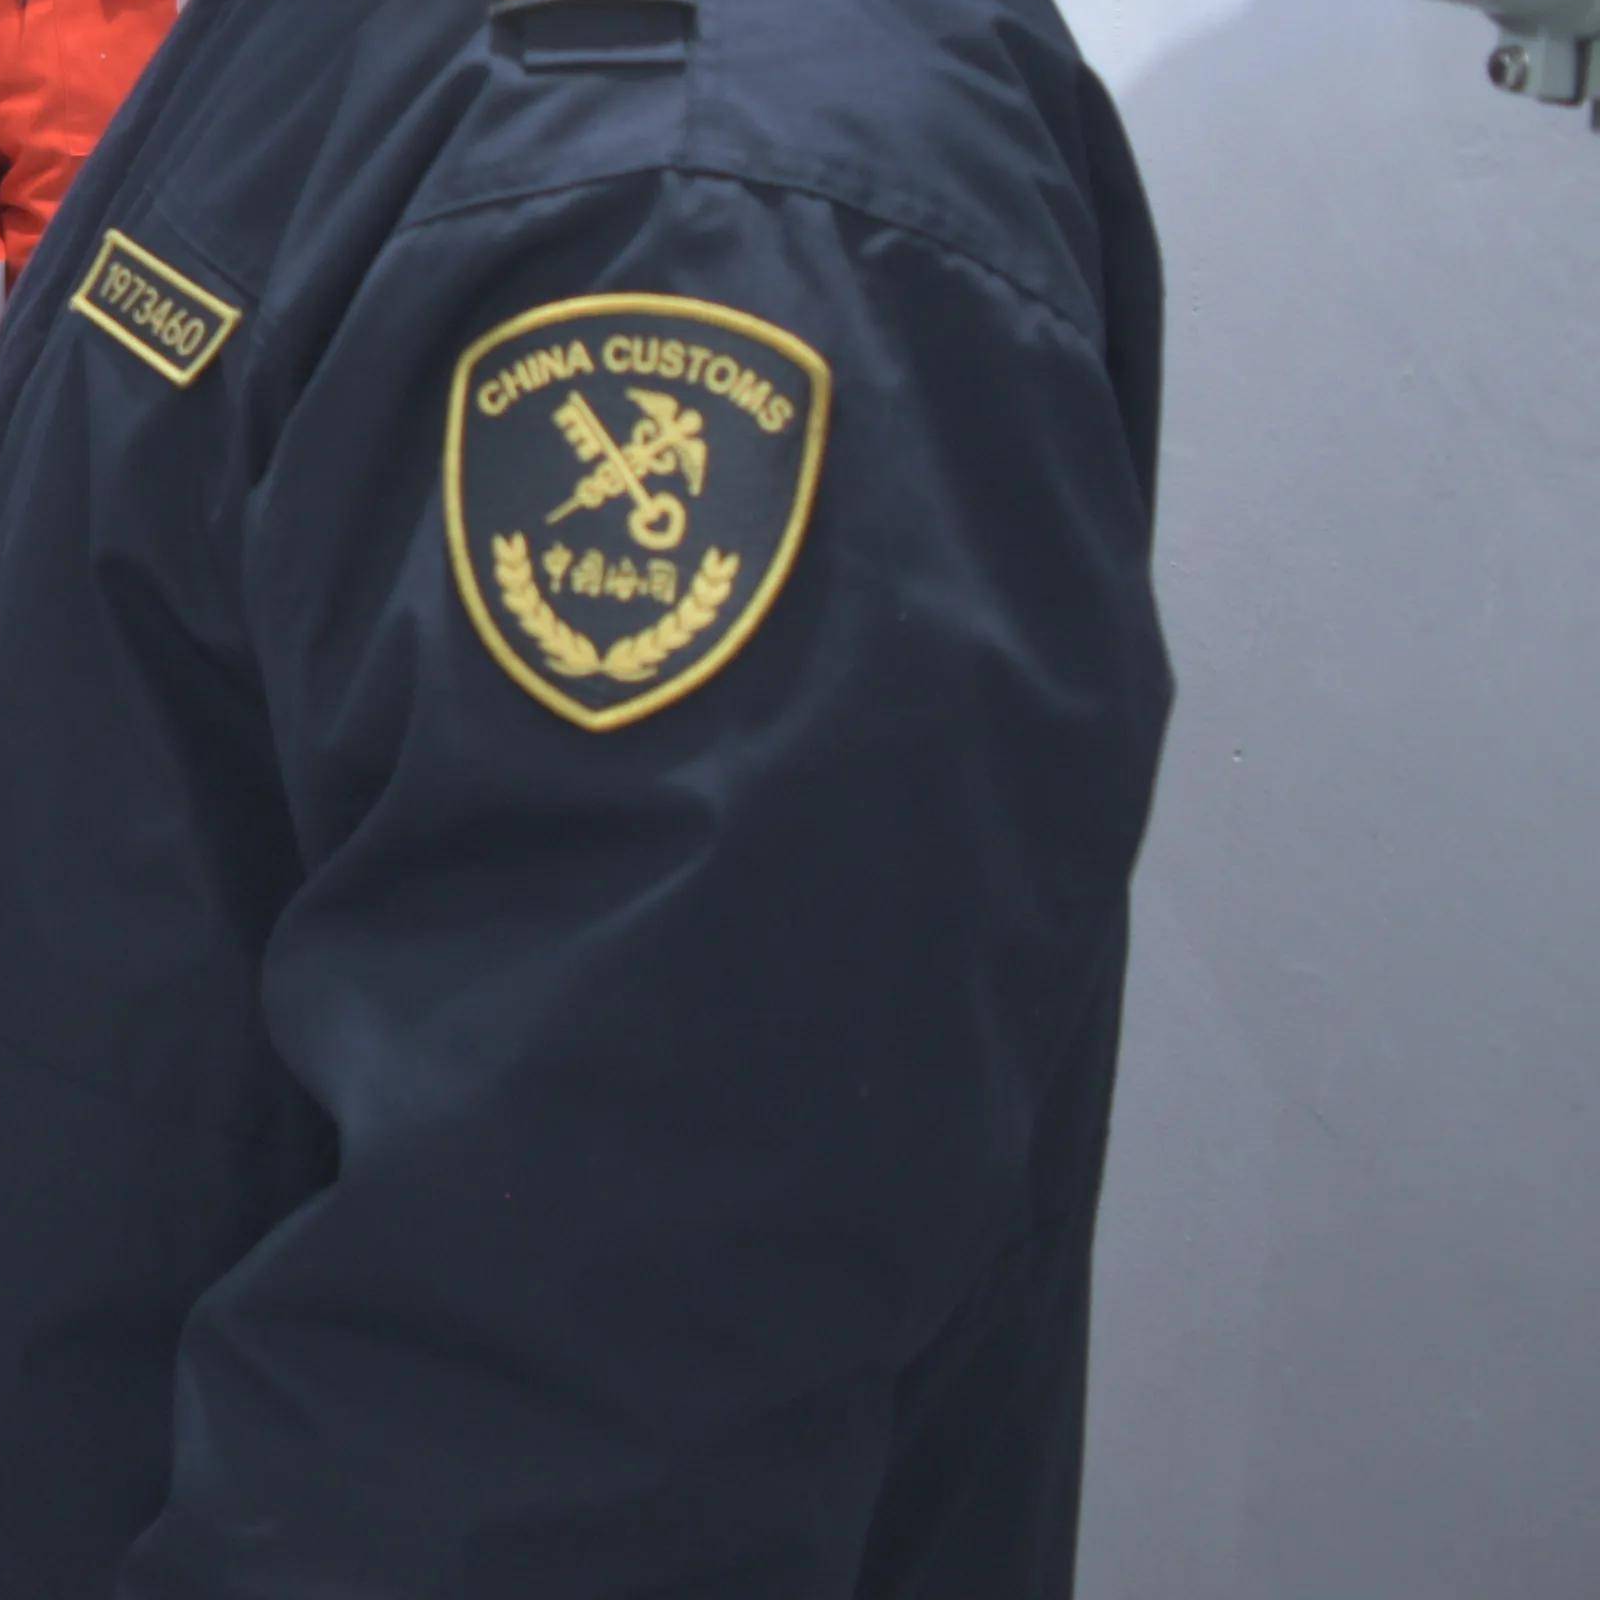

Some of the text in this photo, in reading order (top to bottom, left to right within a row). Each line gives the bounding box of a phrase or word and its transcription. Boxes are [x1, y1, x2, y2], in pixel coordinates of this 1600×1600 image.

[101, 262, 205, 356] 1973460
[477, 335, 795, 433] CHINA CUSTOMS
